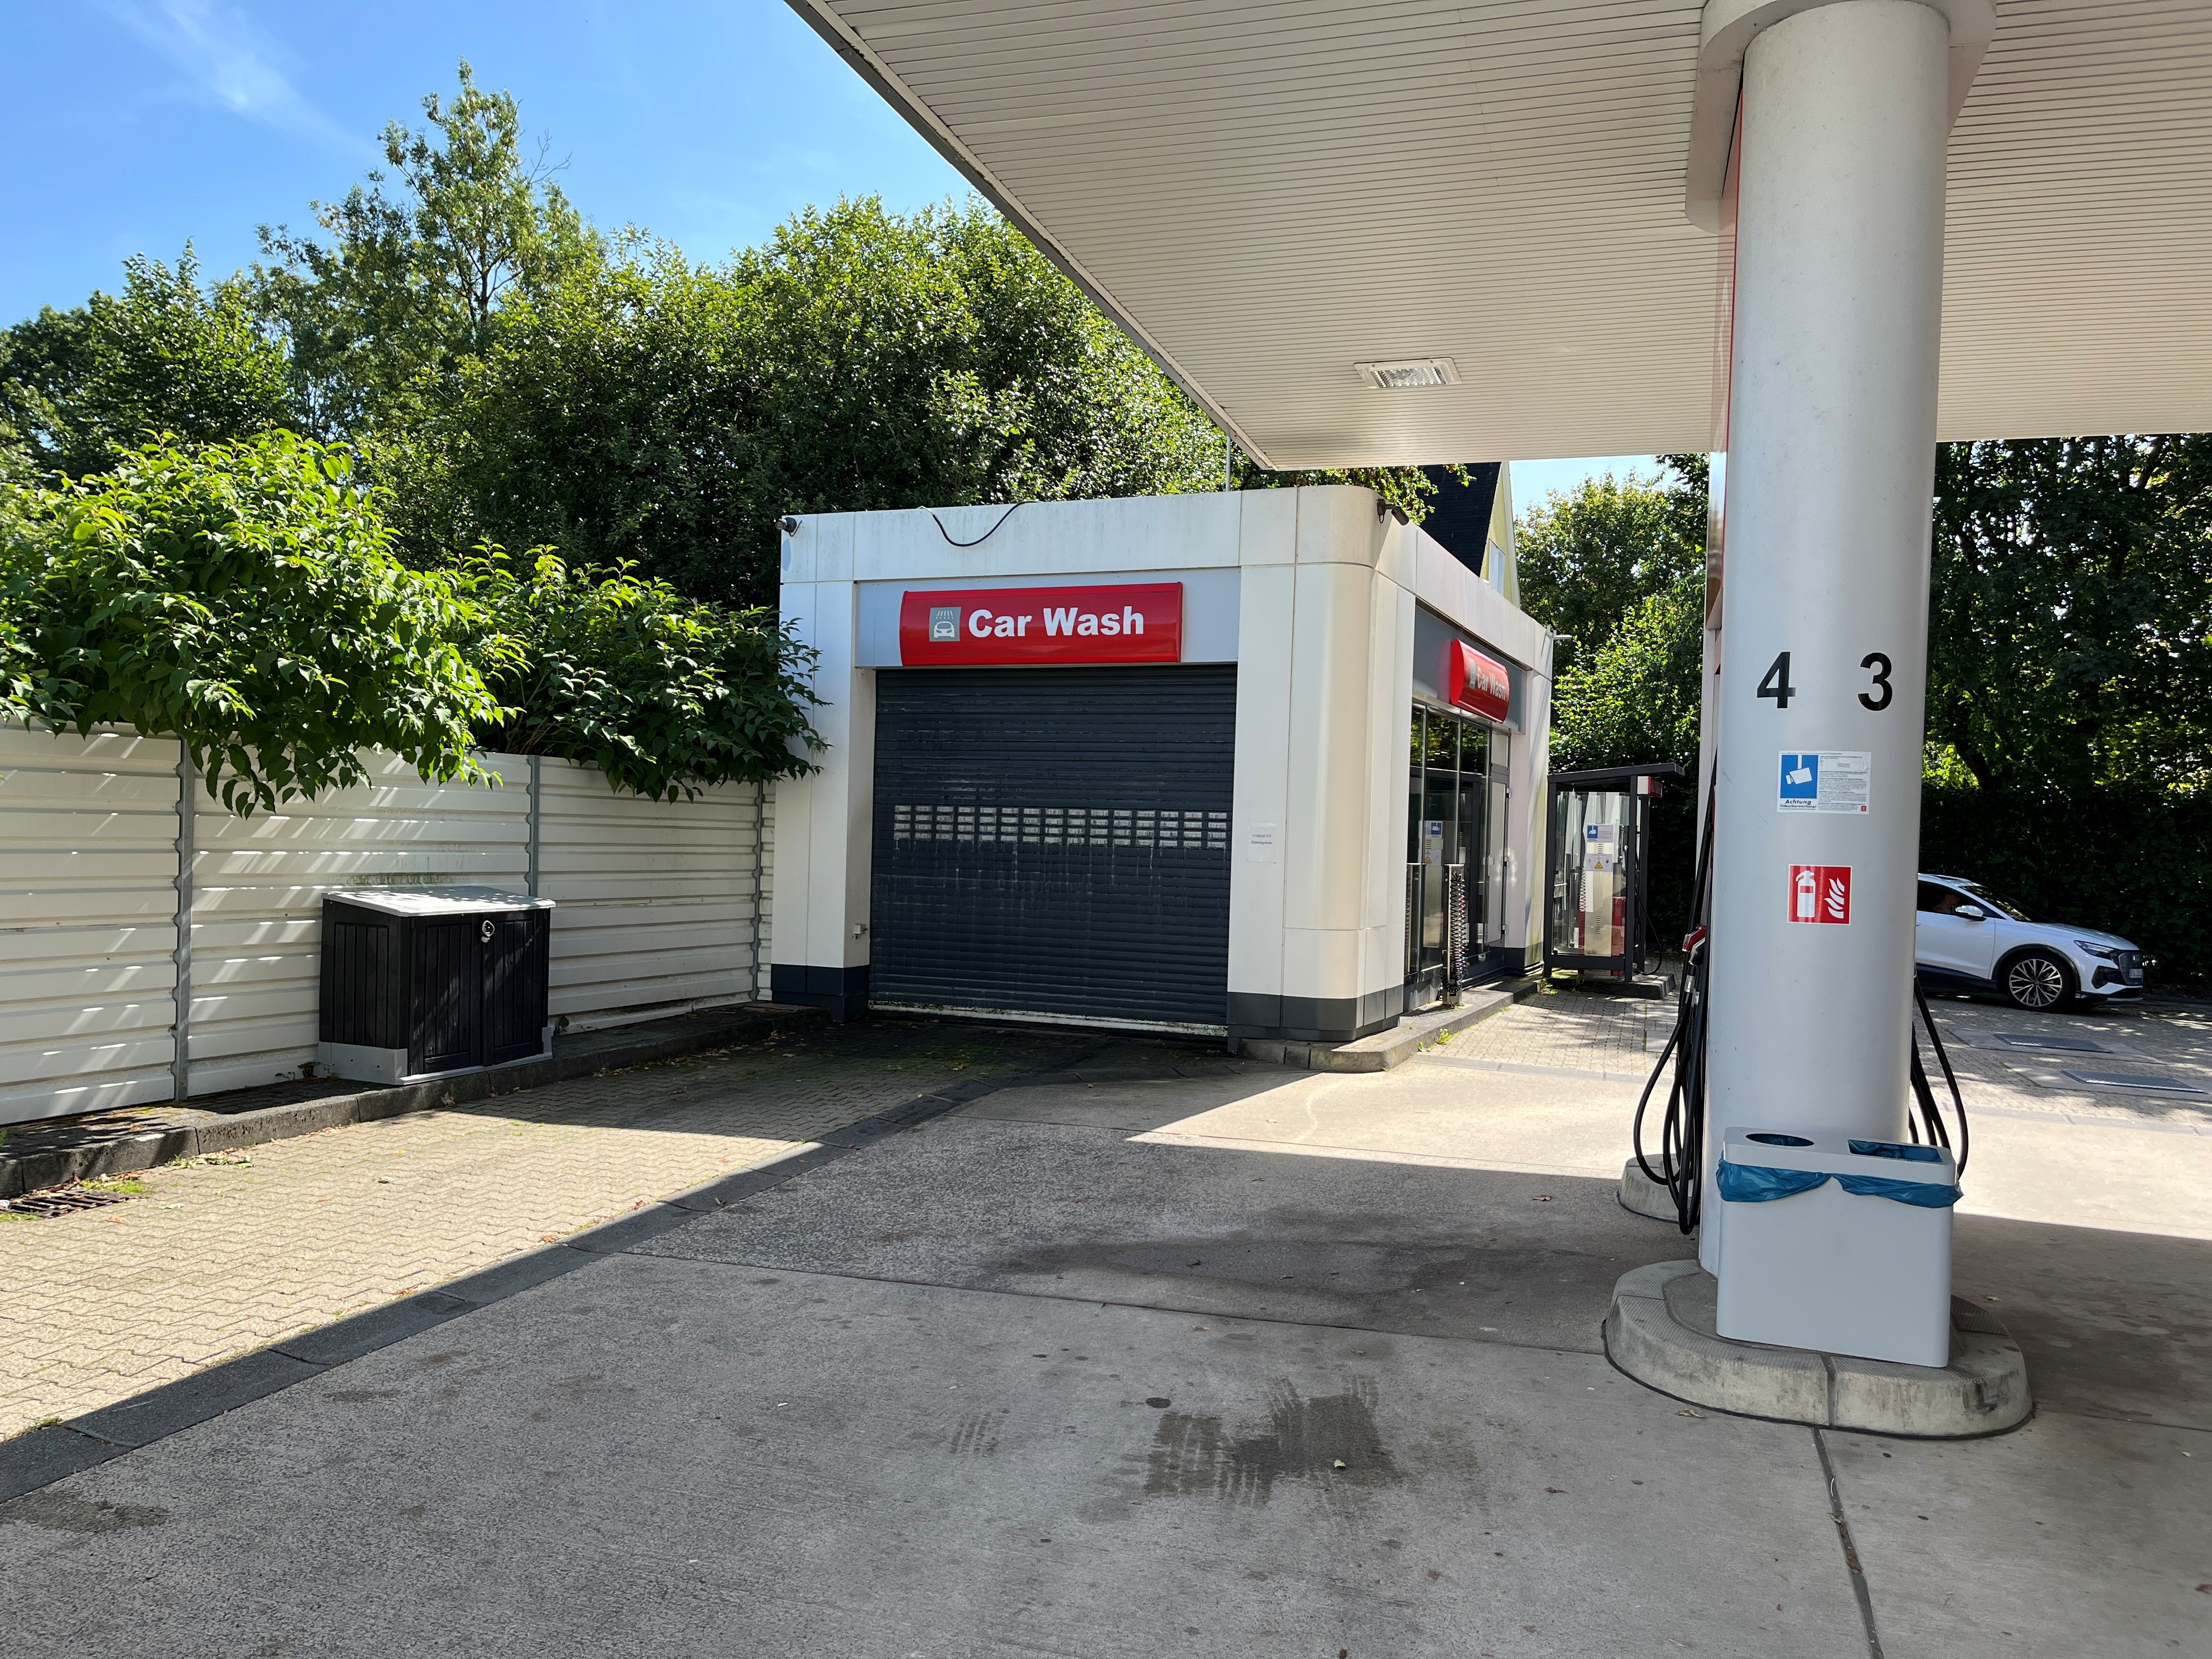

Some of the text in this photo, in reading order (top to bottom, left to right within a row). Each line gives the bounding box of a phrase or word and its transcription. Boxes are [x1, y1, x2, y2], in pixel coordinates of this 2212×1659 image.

[968, 606, 1144, 637] Car Wash
[1476, 665, 1506, 701] Car Wash
[1757, 651, 1796, 709] 4
[1858, 652, 1892, 711] 3
